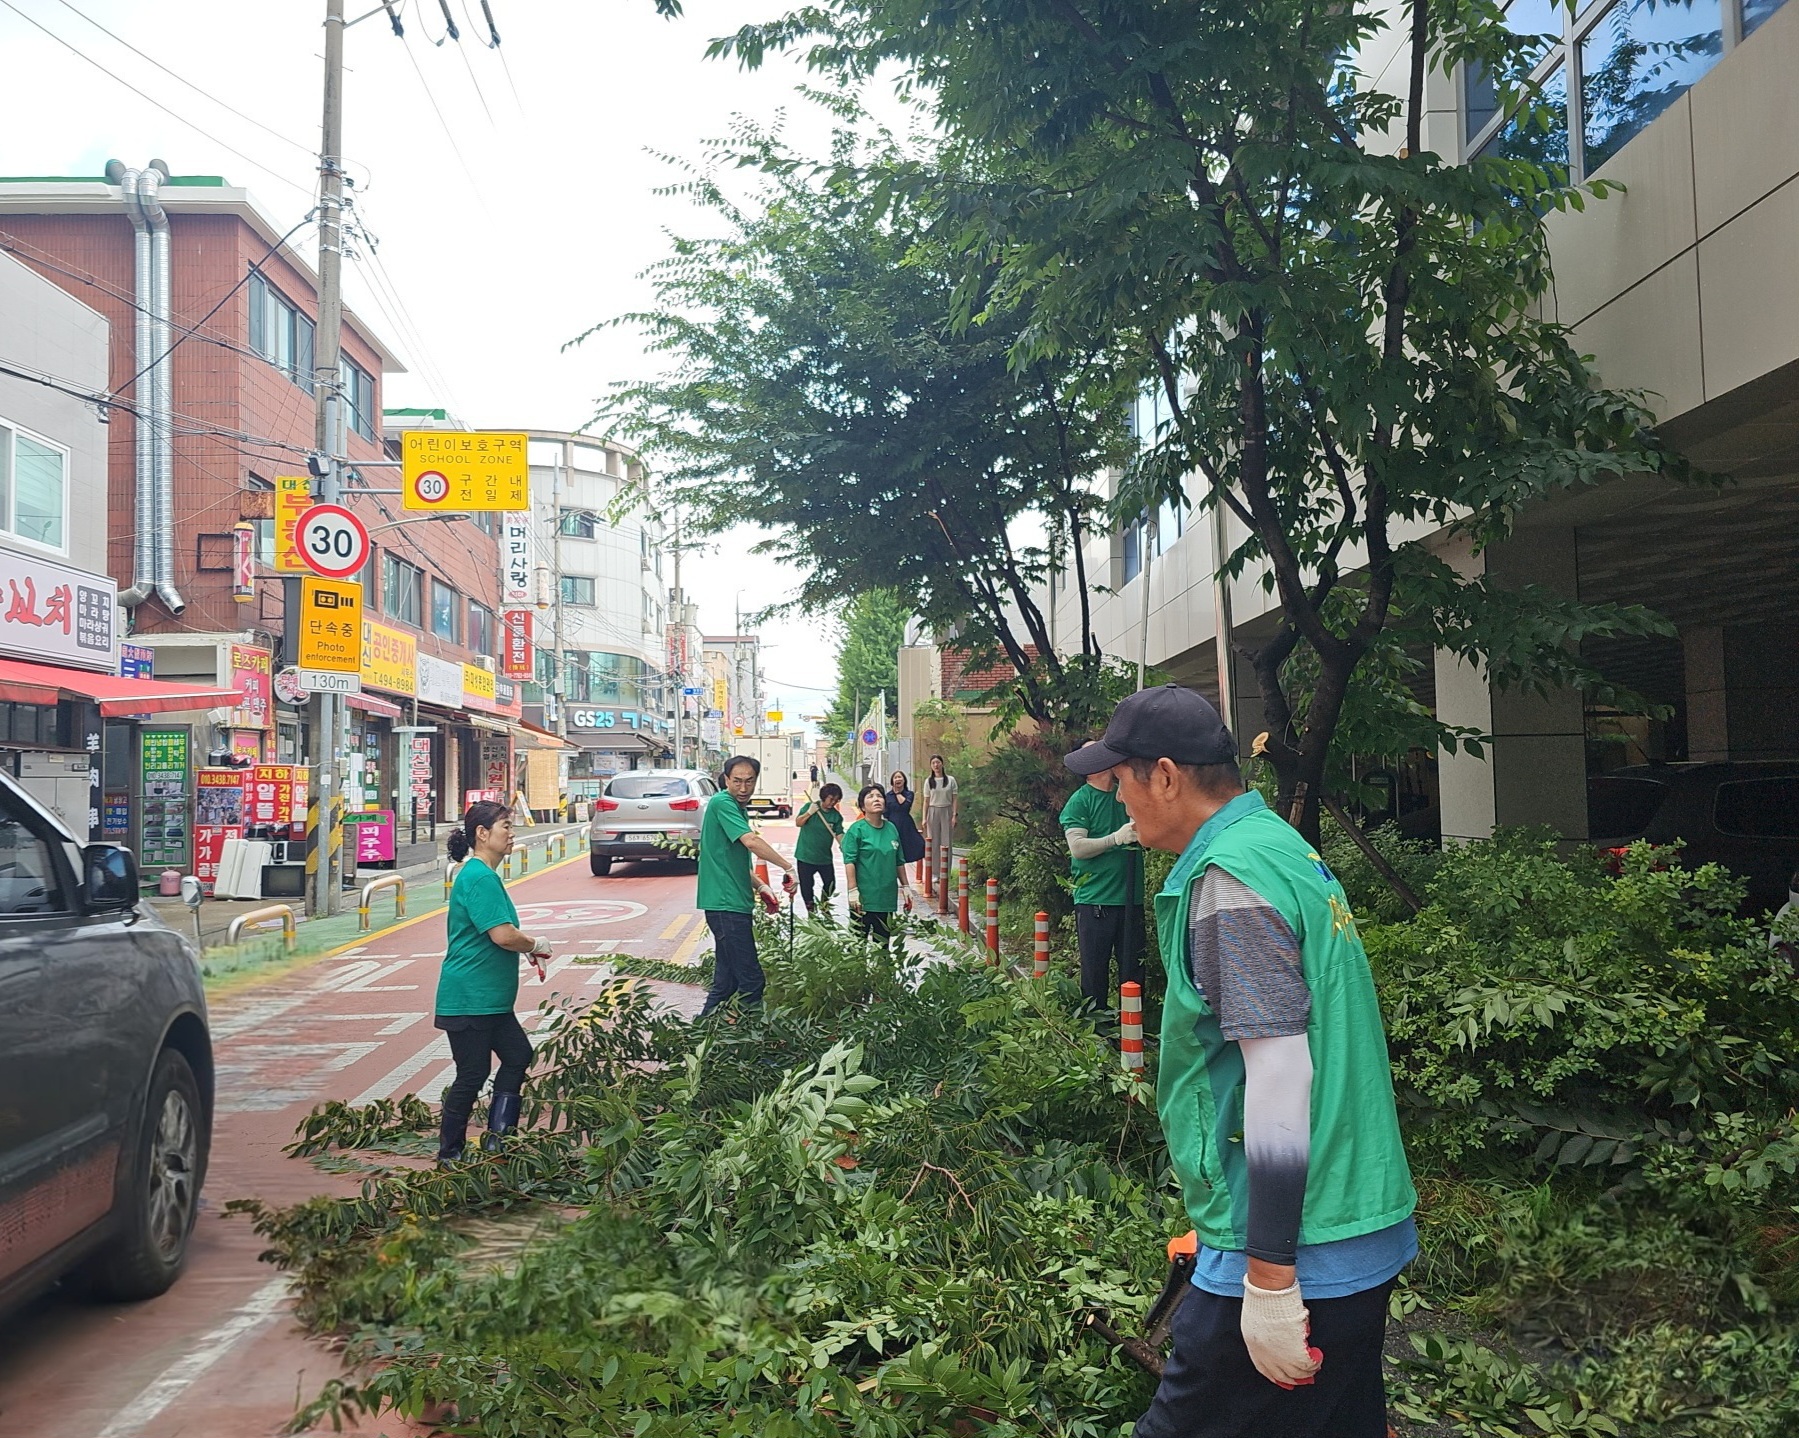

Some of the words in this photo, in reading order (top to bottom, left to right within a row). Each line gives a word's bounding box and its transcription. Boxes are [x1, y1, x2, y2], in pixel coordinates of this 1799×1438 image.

[410, 437, 522, 453] 어린이보호구역
[420, 454, 471, 464] SCHOOL
[480, 455, 513, 465] ZONE
[423, 479, 442, 495] 30
[311, 525, 353, 558] 30
[510, 526, 528, 588] 머리사랑
[0, 577, 72, 635] 꼬치
[310, 619, 354, 638] 단속중
[317, 641, 345, 653] Photo
[362, 622, 372, 668] 대신
[373, 632, 414, 668] 공인중개사
[233, 651, 269, 674] 로즈카페
[306, 653, 356, 664] enforcement
[245, 678, 259, 694] 커피
[311, 674, 349, 690] 130m
[574, 710, 616, 729] GS25
[258, 768, 289, 780] 지하
